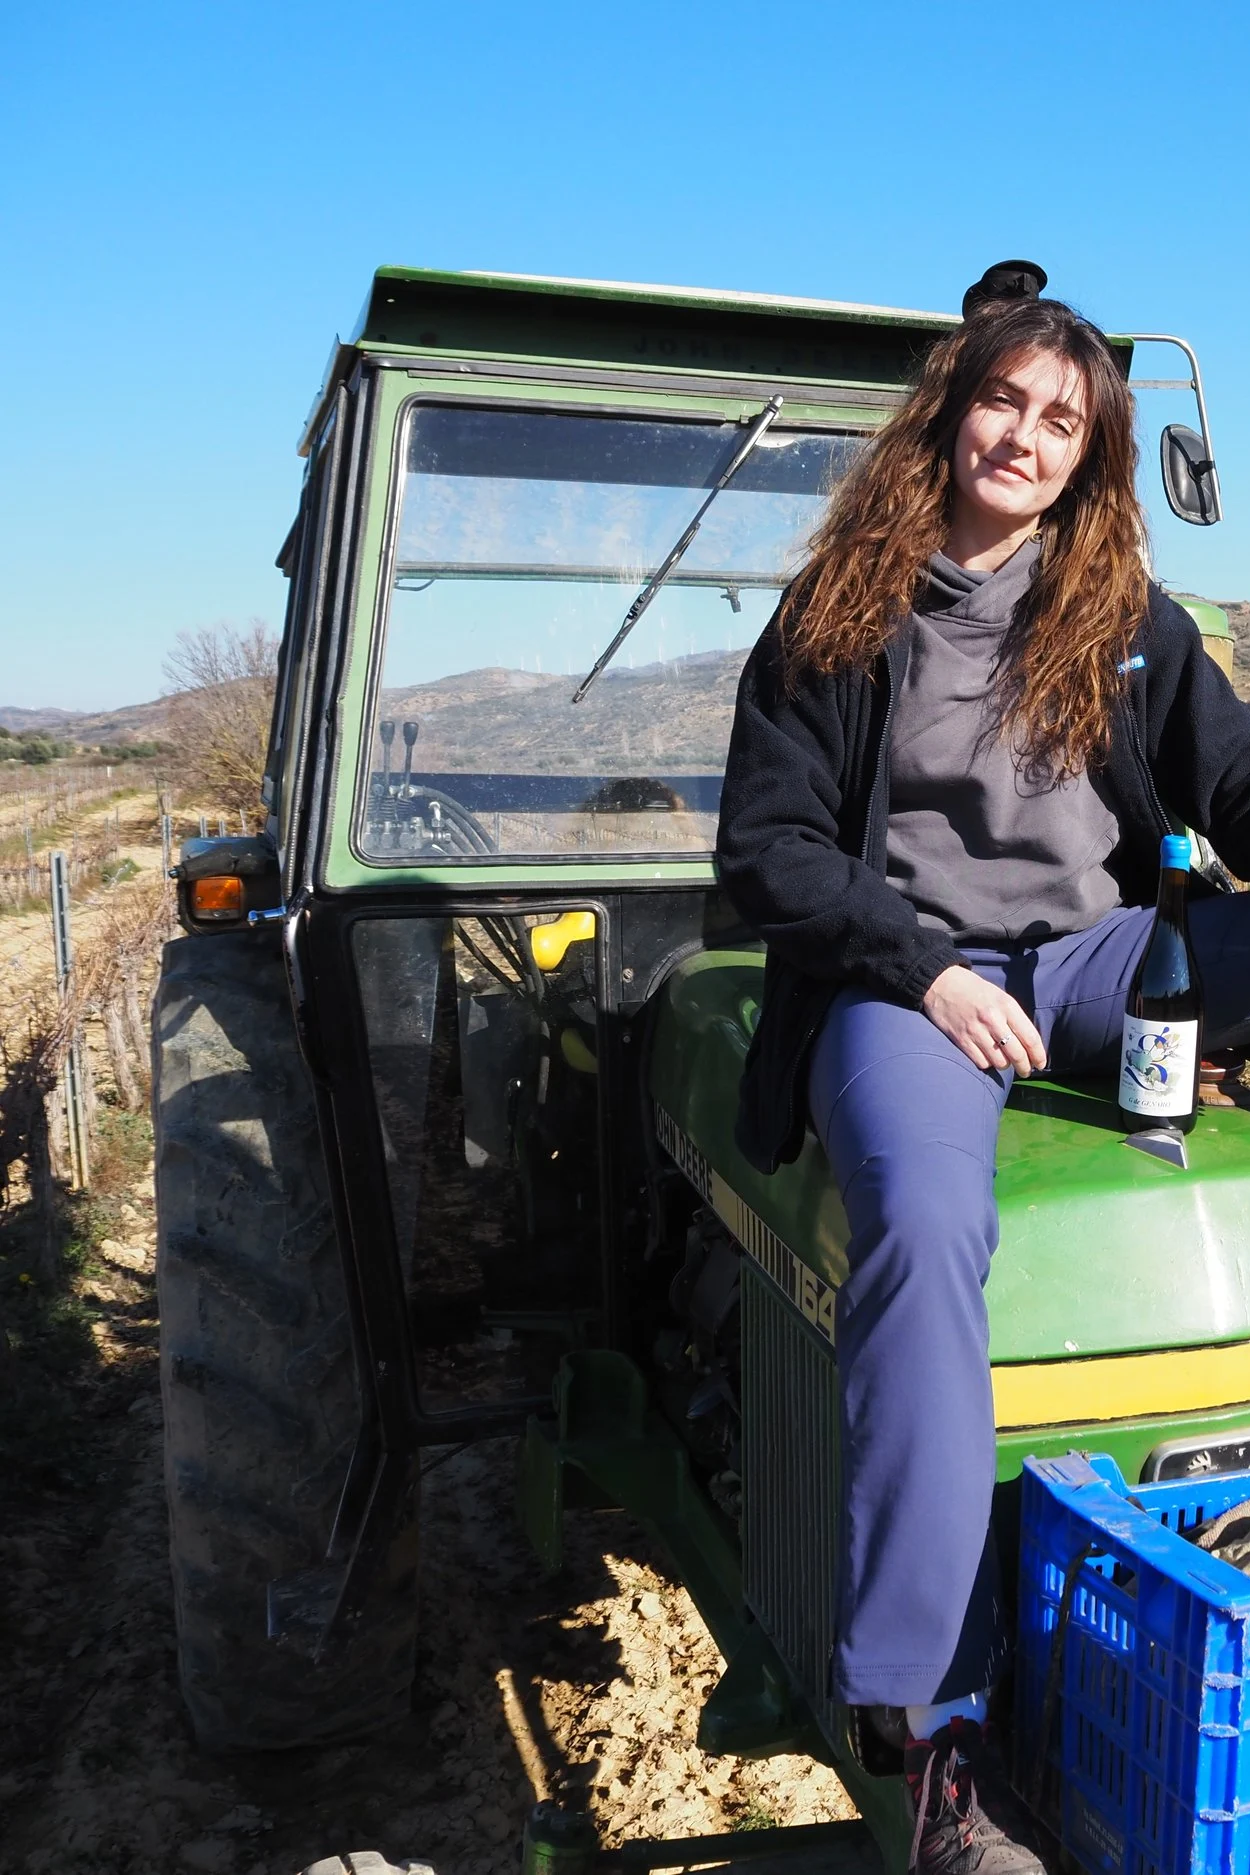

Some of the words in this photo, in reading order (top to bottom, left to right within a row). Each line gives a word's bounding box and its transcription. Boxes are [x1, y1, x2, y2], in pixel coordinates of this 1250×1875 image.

[633, 335, 743, 361] JOHN
[655, 1102, 676, 1158] OHN
[679, 1132, 713, 1206] DEERE
